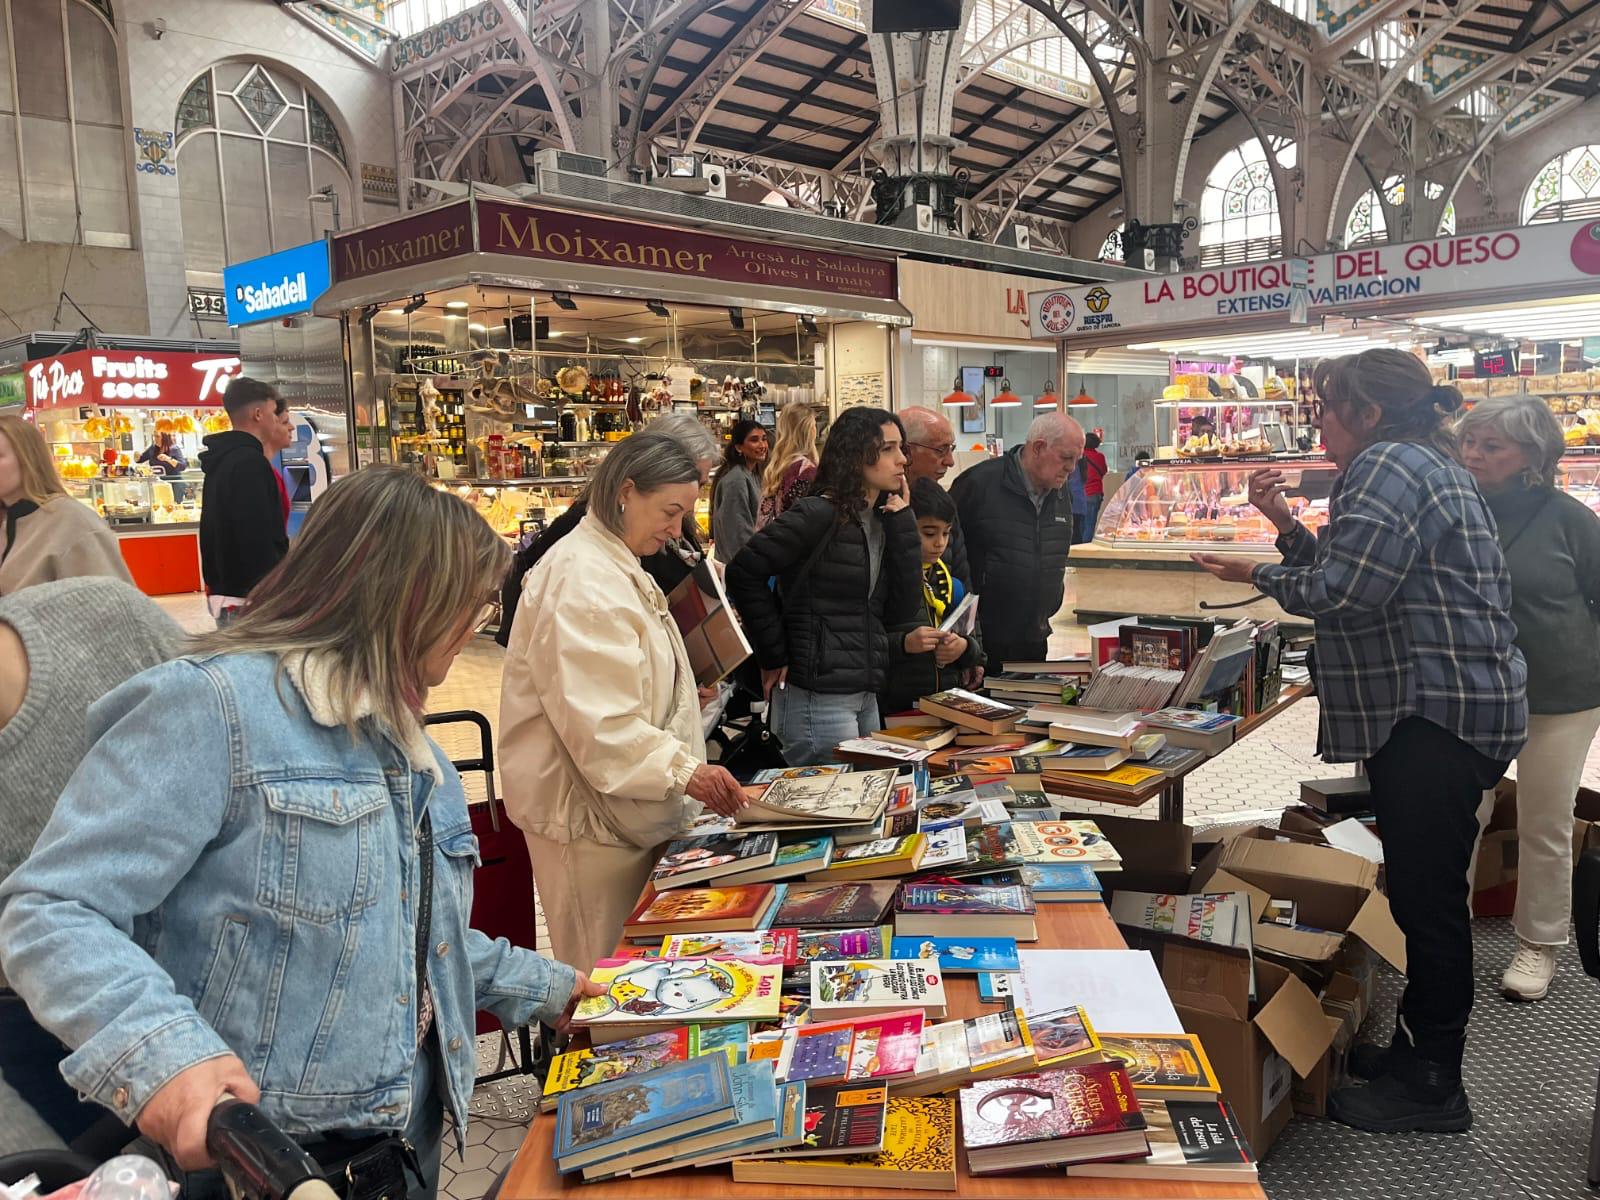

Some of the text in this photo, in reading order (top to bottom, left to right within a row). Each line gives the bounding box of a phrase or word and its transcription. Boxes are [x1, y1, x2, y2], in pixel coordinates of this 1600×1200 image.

[344, 224, 466, 276] Moixamer
[496, 212, 713, 273] Moixamer
[744, 261, 799, 279] Olives
[816, 270, 873, 288] Fumats
[791, 254, 810, 266] de
[816, 257, 887, 277] Saladura
[1144, 280, 1175, 304] LA
[1336, 251, 1387, 280] DEL
[1404, 233, 1521, 271] QUESO
[244, 272, 307, 313] Sabadell
[1006, 288, 1027, 315] LA
[1308, 276, 1421, 305] VARIACION
[91, 356, 168, 379] Fruits
[192, 357, 243, 400] Ti
[1483, 358, 1505, 374] 42
[102, 383, 160, 399] socs
[756, 973, 775, 998] Lola
[866, 1091, 882, 1101] 13
[1063, 1073, 1094, 1130] COURAGE
[1190, 1116, 1210, 1150] del tesoro
[1207, 1122, 1225, 1145] La isla
